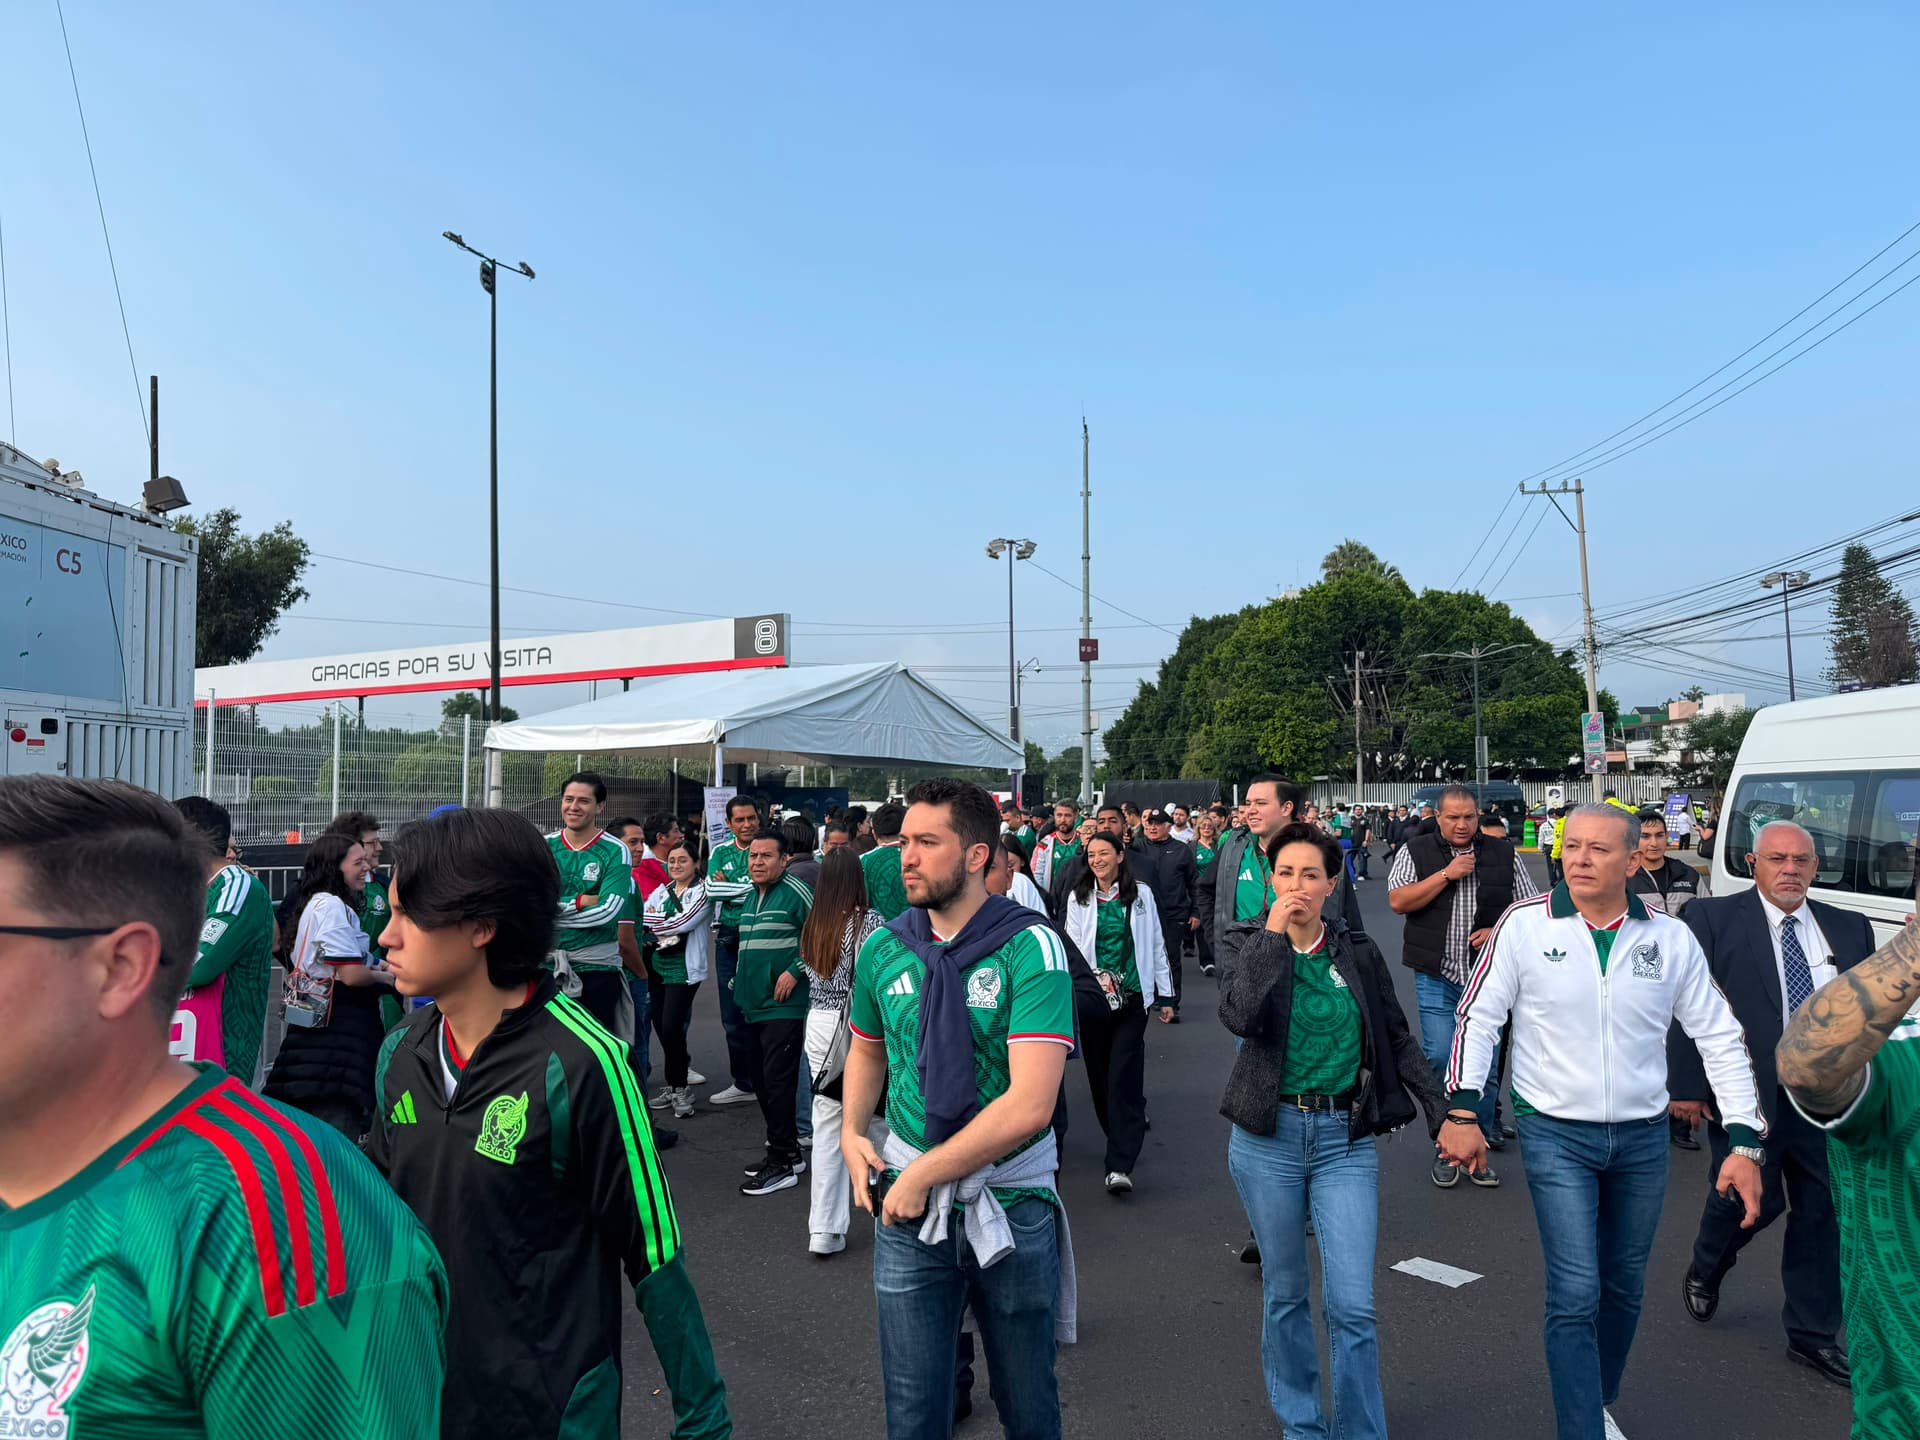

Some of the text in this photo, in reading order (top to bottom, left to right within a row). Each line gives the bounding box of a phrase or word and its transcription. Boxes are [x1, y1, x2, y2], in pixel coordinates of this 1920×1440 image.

[0, 533, 27, 550] XICO
[56, 548, 82, 575] C5
[755, 619, 777, 654] 8
[312, 661, 390, 682] GRACIAS
[398, 656, 439, 676] POR
[448, 653, 475, 672] SU
[479, 1138, 511, 1159] MÉXICO
[0, 1410, 65, 1438] ÉXICO
